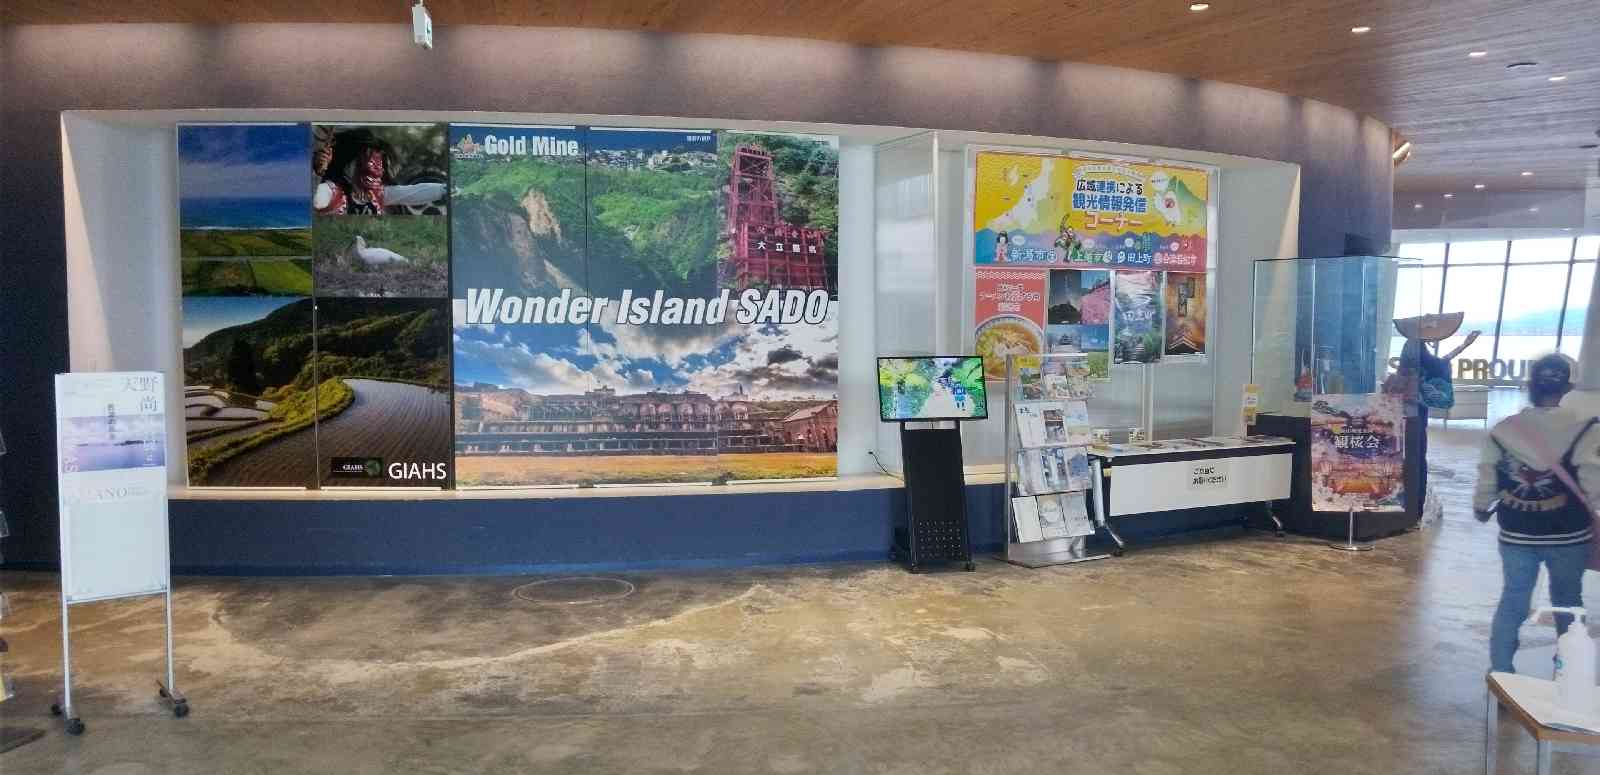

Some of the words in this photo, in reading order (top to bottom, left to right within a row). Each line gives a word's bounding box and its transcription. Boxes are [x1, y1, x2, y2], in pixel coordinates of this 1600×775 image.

[484, 134, 527, 156] Gold
[532, 135, 578, 157] Mine
[1076, 178, 1143, 196] 広域連携による
[1072, 191, 1148, 213] 観光情報発信
[1084, 212, 1144, 230] コーナー
[464, 286, 609, 326] Wonder
[616, 287, 729, 326] Island
[735, 288, 830, 326] SADO
[1457, 358, 1534, 381] PROU
[1335, 434, 1379, 449] 観桜会
[388, 462, 447, 480] GIAHS
